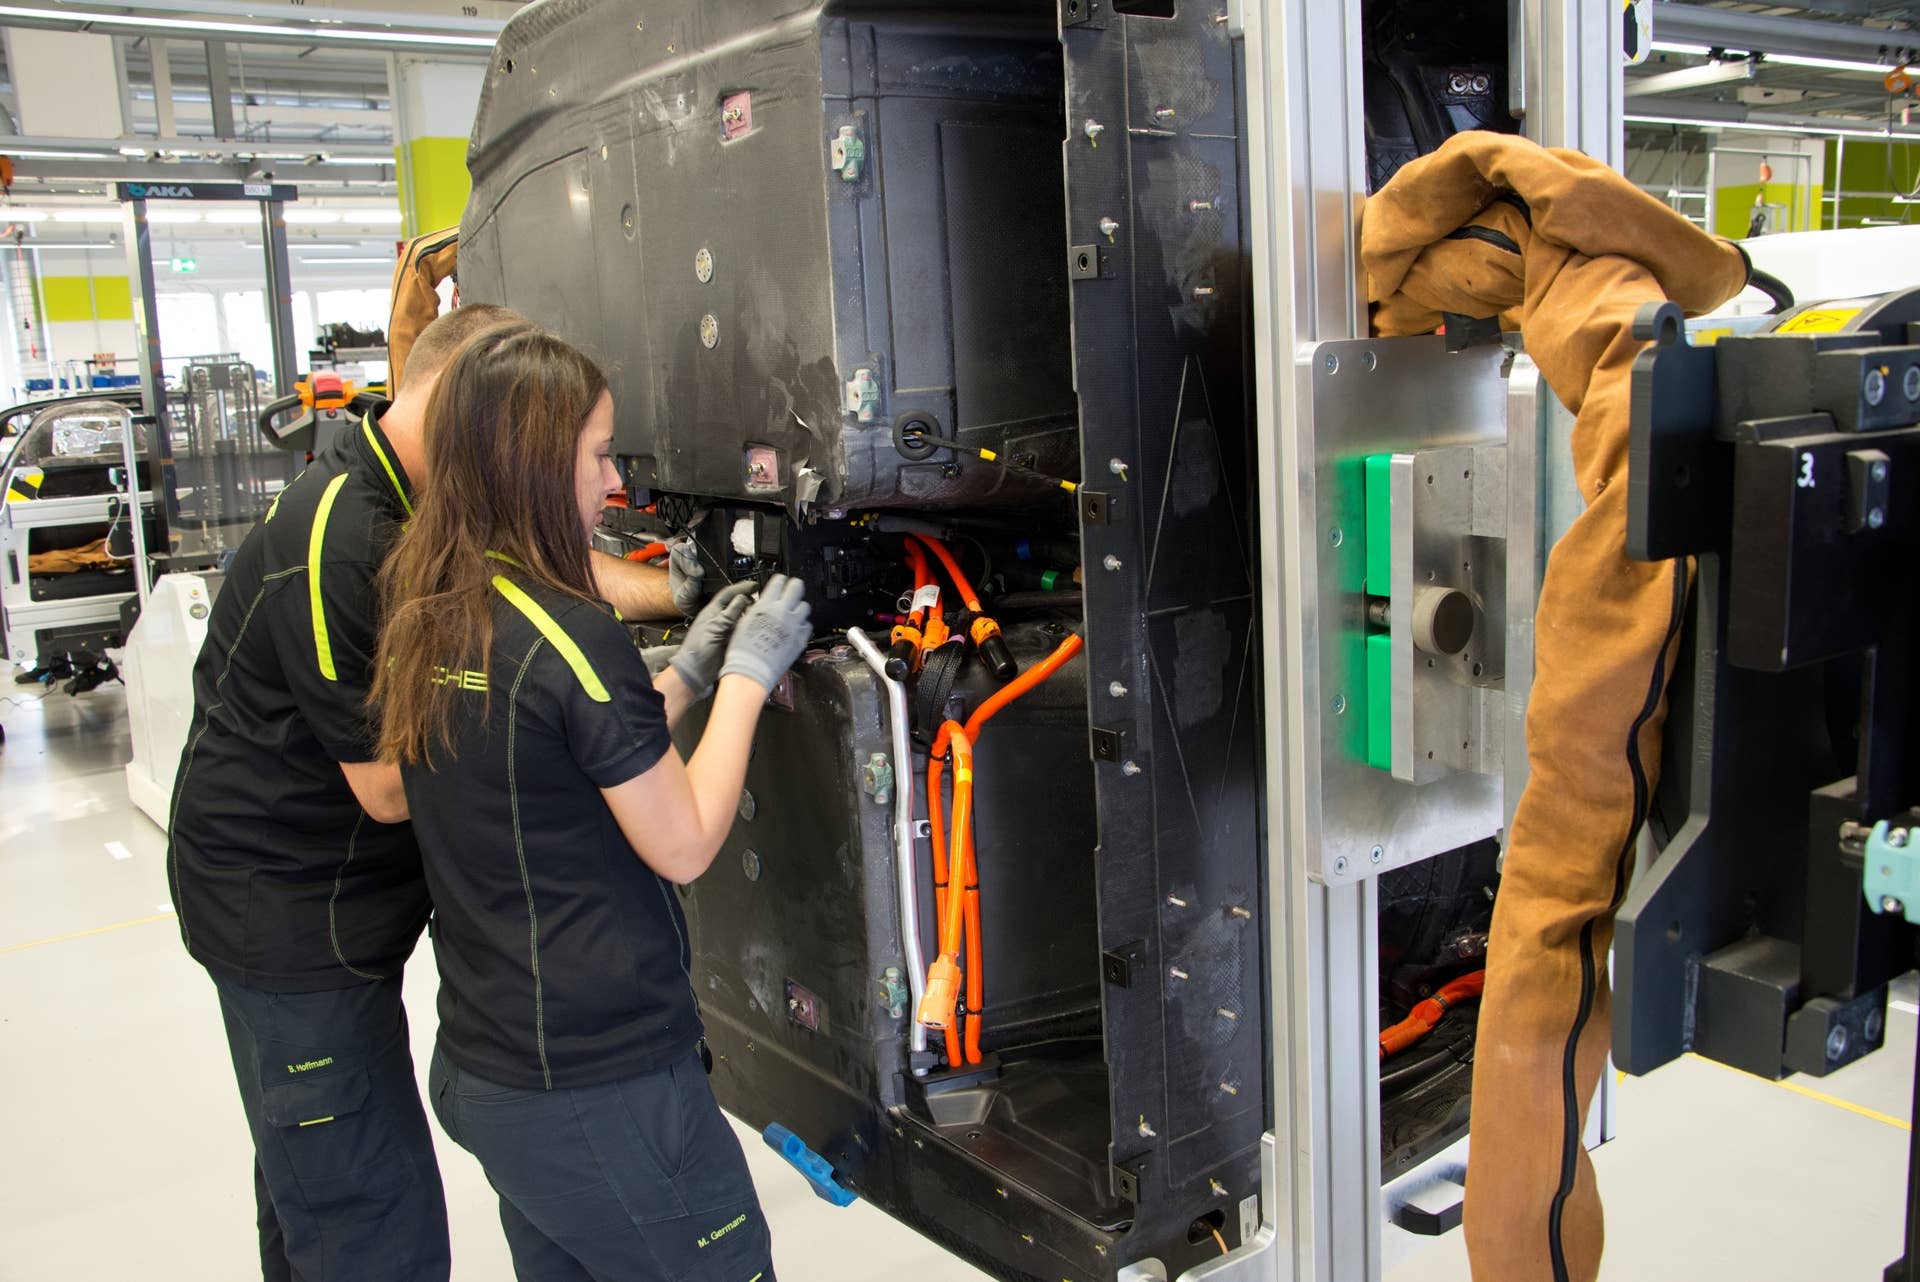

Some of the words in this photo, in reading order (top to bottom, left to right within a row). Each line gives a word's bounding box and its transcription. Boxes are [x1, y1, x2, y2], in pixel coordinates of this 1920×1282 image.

[462, 6, 478, 17] 119
[287, 1065, 297, 1073] B.
[296, 1057, 333, 1071] Hoffmann
[697, 1237, 710, 1248] M.
[711, 1214, 746, 1240] Germano
